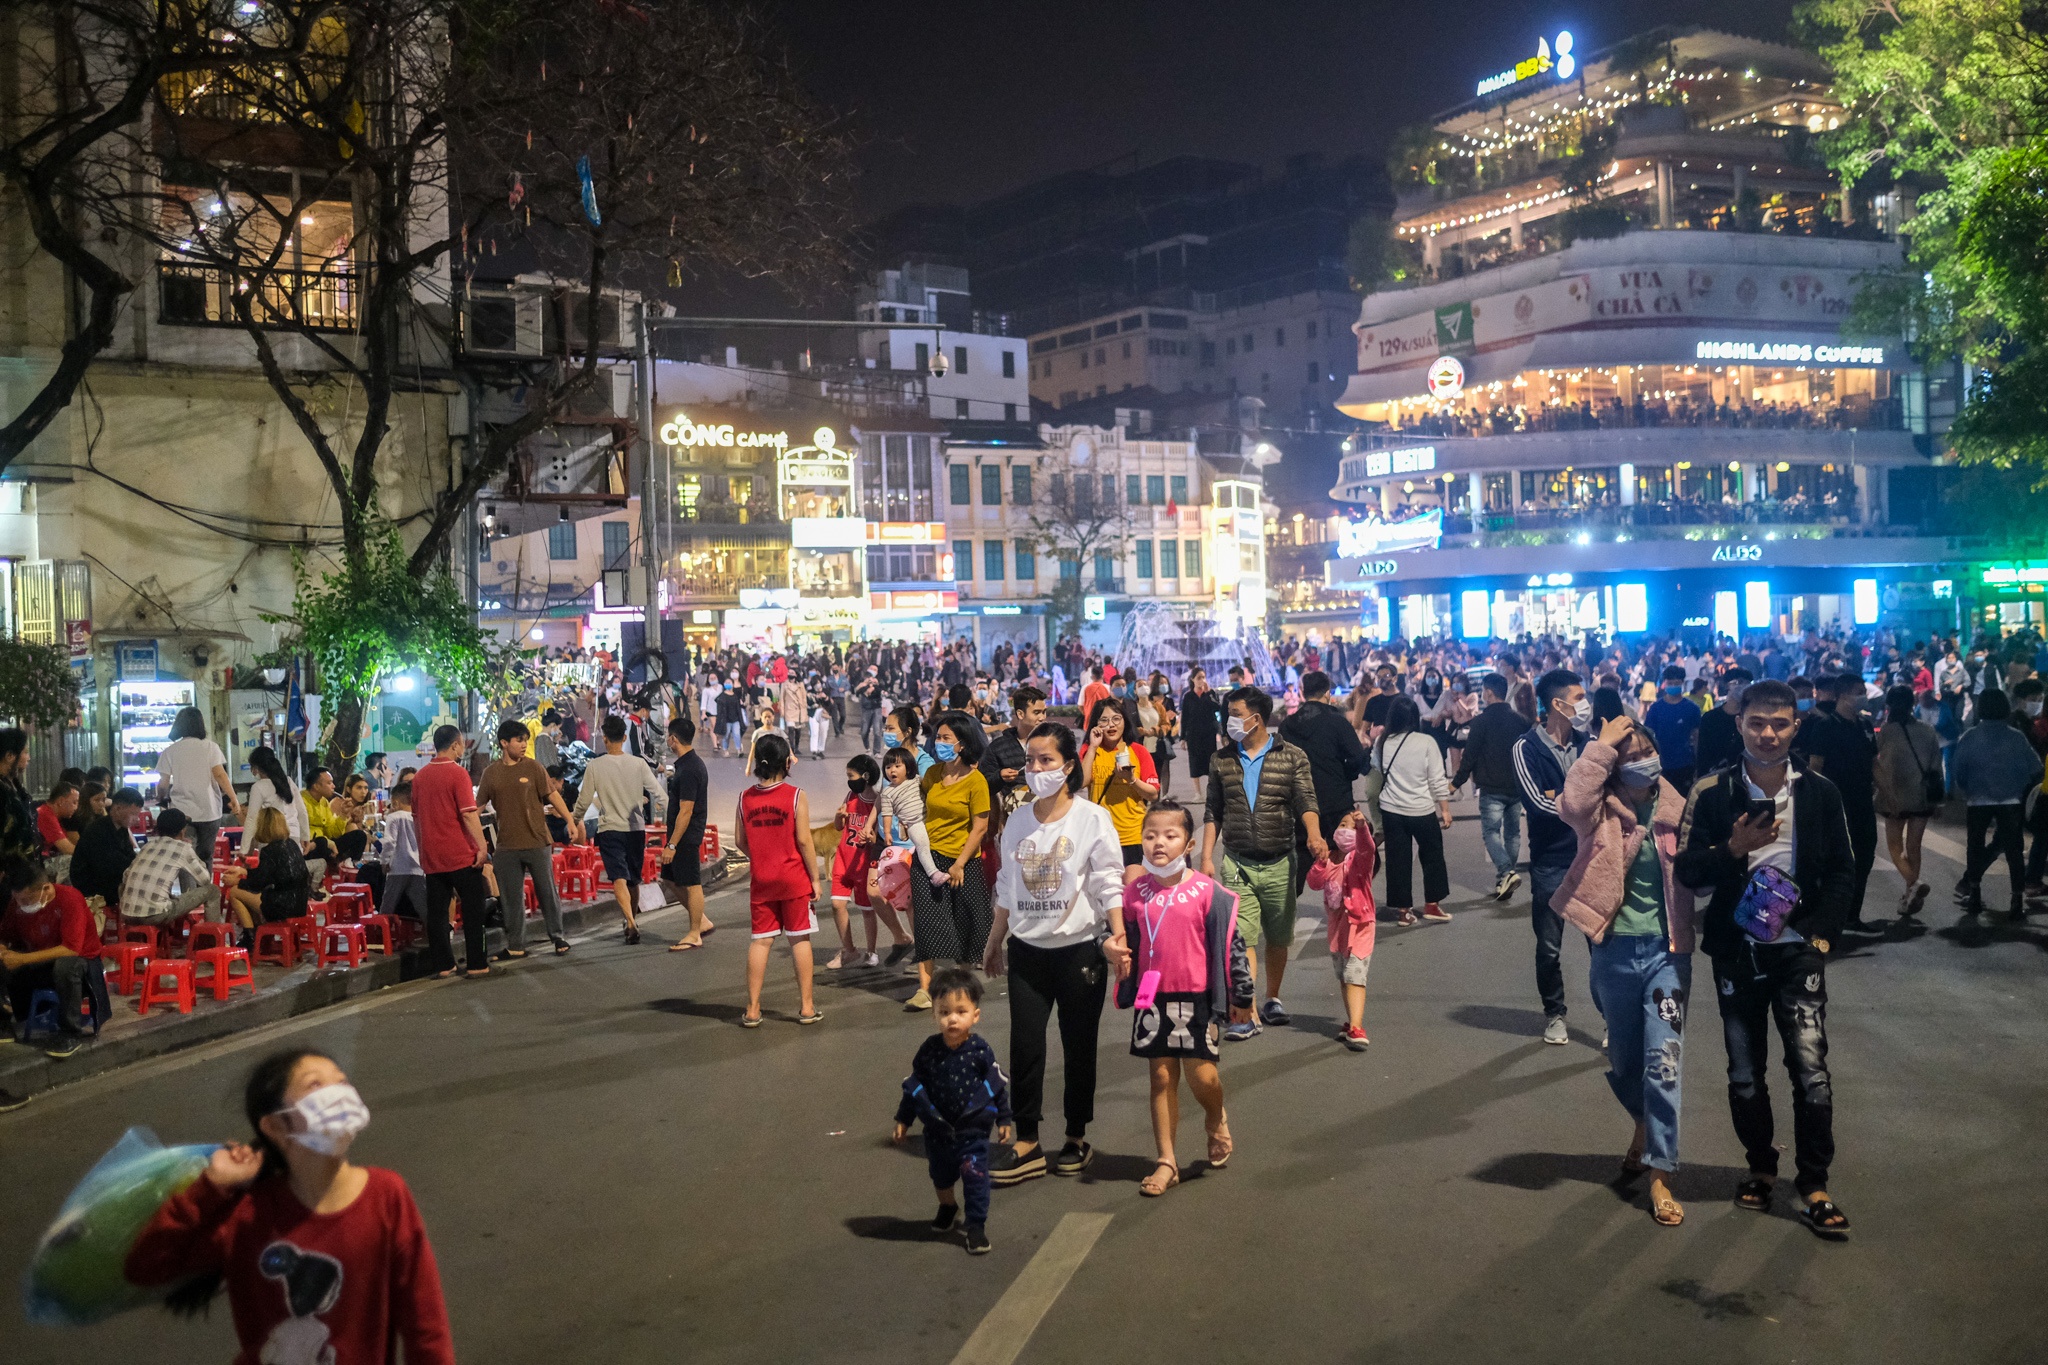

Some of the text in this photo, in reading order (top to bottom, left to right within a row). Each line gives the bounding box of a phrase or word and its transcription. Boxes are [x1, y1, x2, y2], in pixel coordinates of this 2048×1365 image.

[1618, 270, 1663, 290] VUA
[1696, 341, 1883, 363] HIGHLANDS COFFEE
[1712, 544, 1762, 562] ALDO
[1358, 559, 1398, 577] ALDO
[1527, 572, 1573, 587] ALDO
[1682, 616, 1709, 627] ALDO
[1017, 899, 1070, 911] BURBERRY
